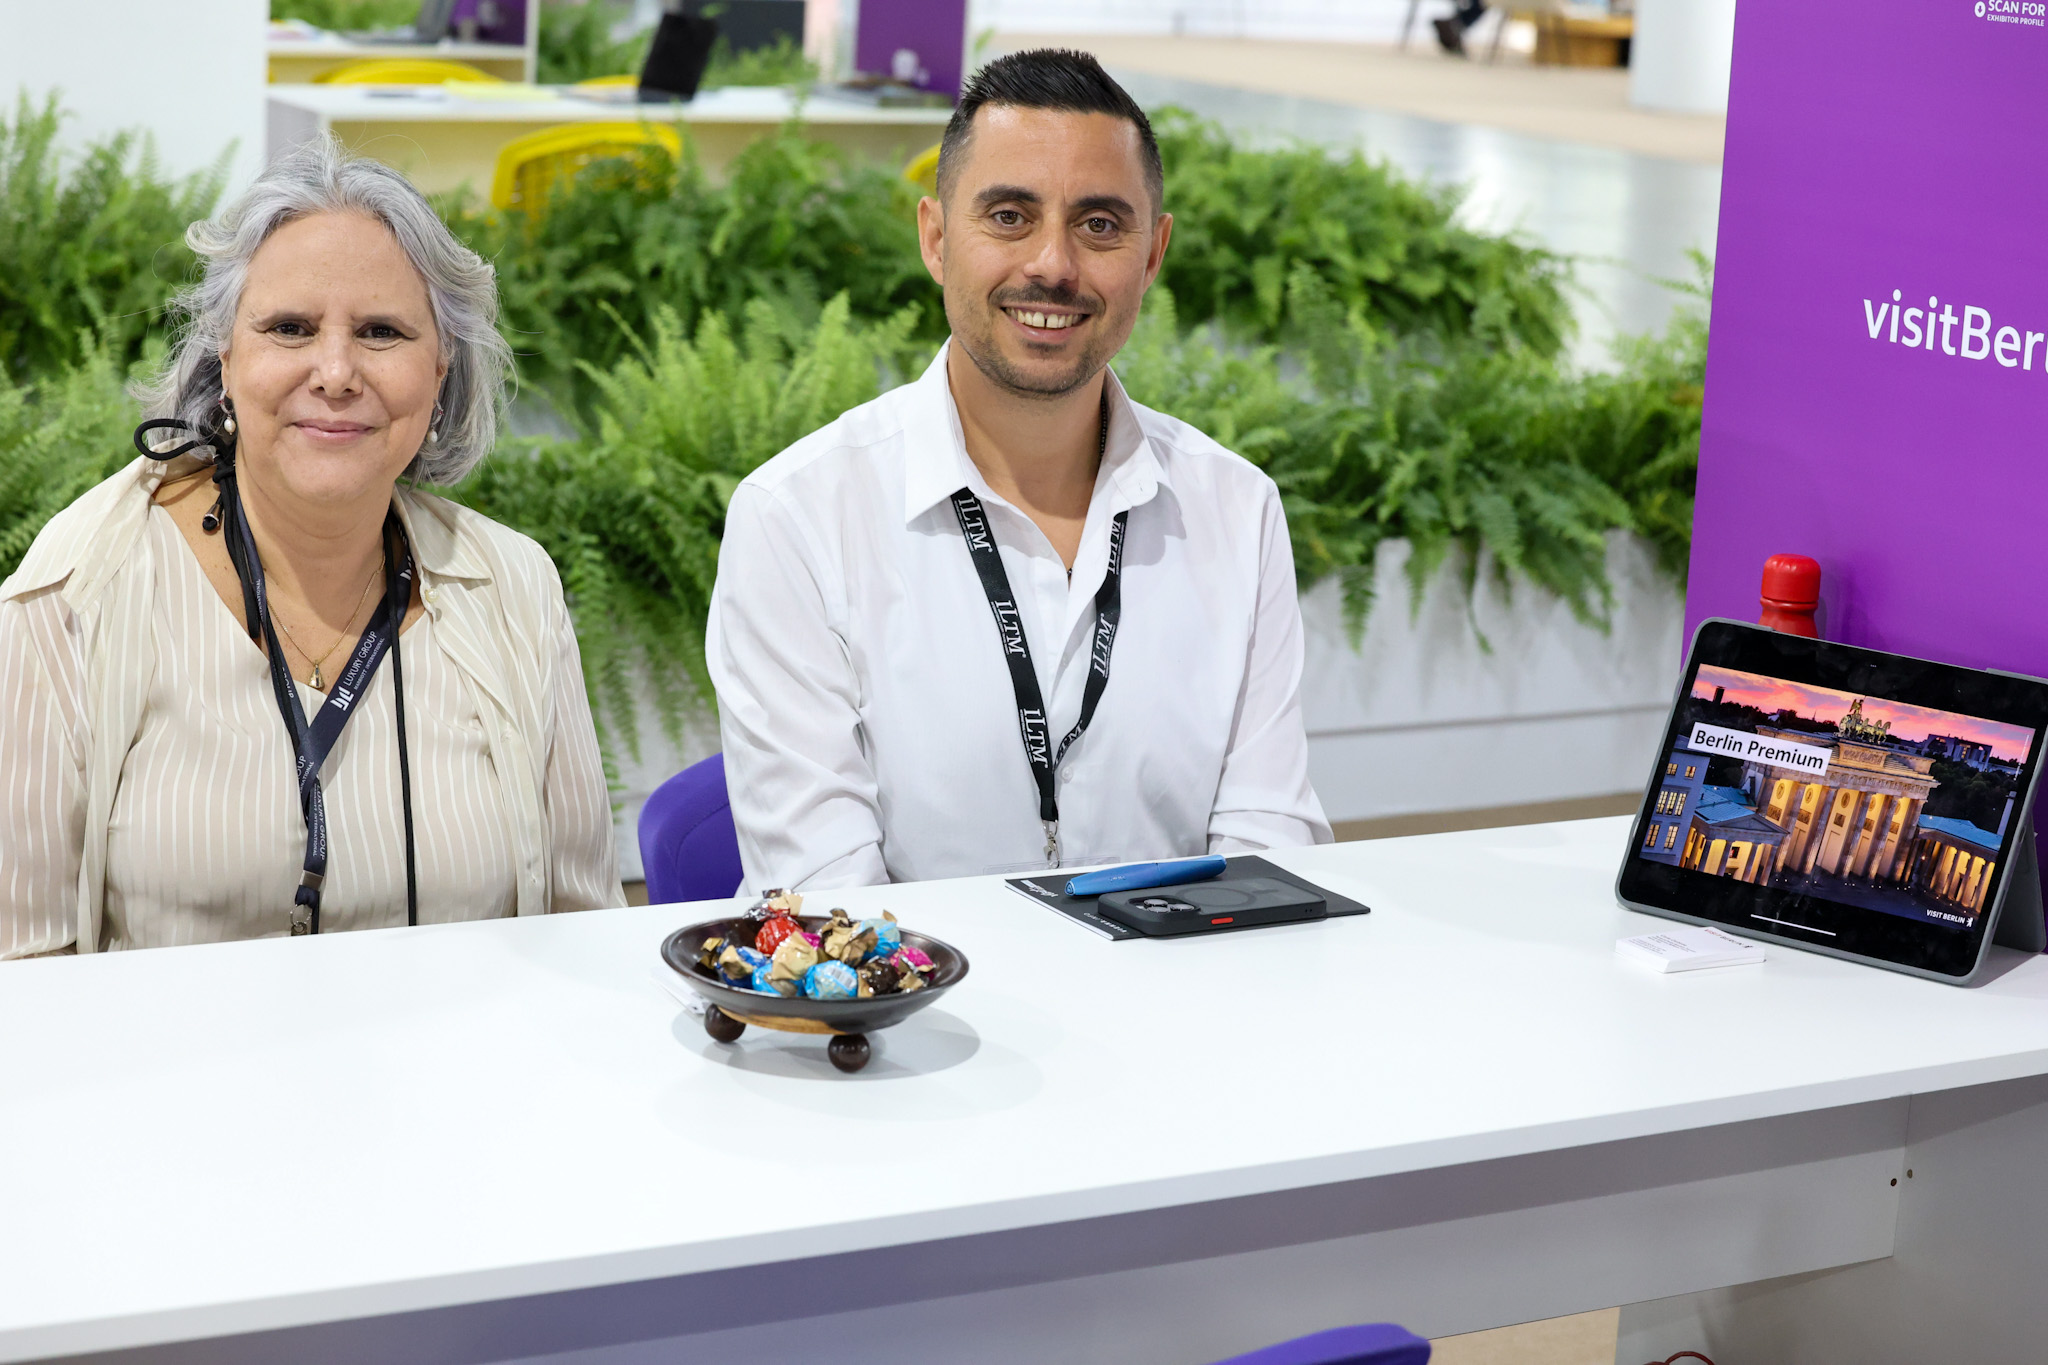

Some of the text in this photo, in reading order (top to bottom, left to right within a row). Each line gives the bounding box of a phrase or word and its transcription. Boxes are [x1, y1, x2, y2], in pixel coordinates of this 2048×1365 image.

[1987, 14, 2045, 27] EXHIBITOR PROFILE
[1988, 0, 2046, 17] SCAN FOR
[957, 497, 992, 551] ILTM
[994, 600, 1026, 656] ILTM
[1092, 615, 1114, 677] ILTM
[343, 631, 378, 686] LUXURY GROUP
[1023, 708, 1048, 765] ILTM
[1694, 730, 1824, 769] Berlin Premium
[1926, 909, 1966, 924] VISIT BERLIN
